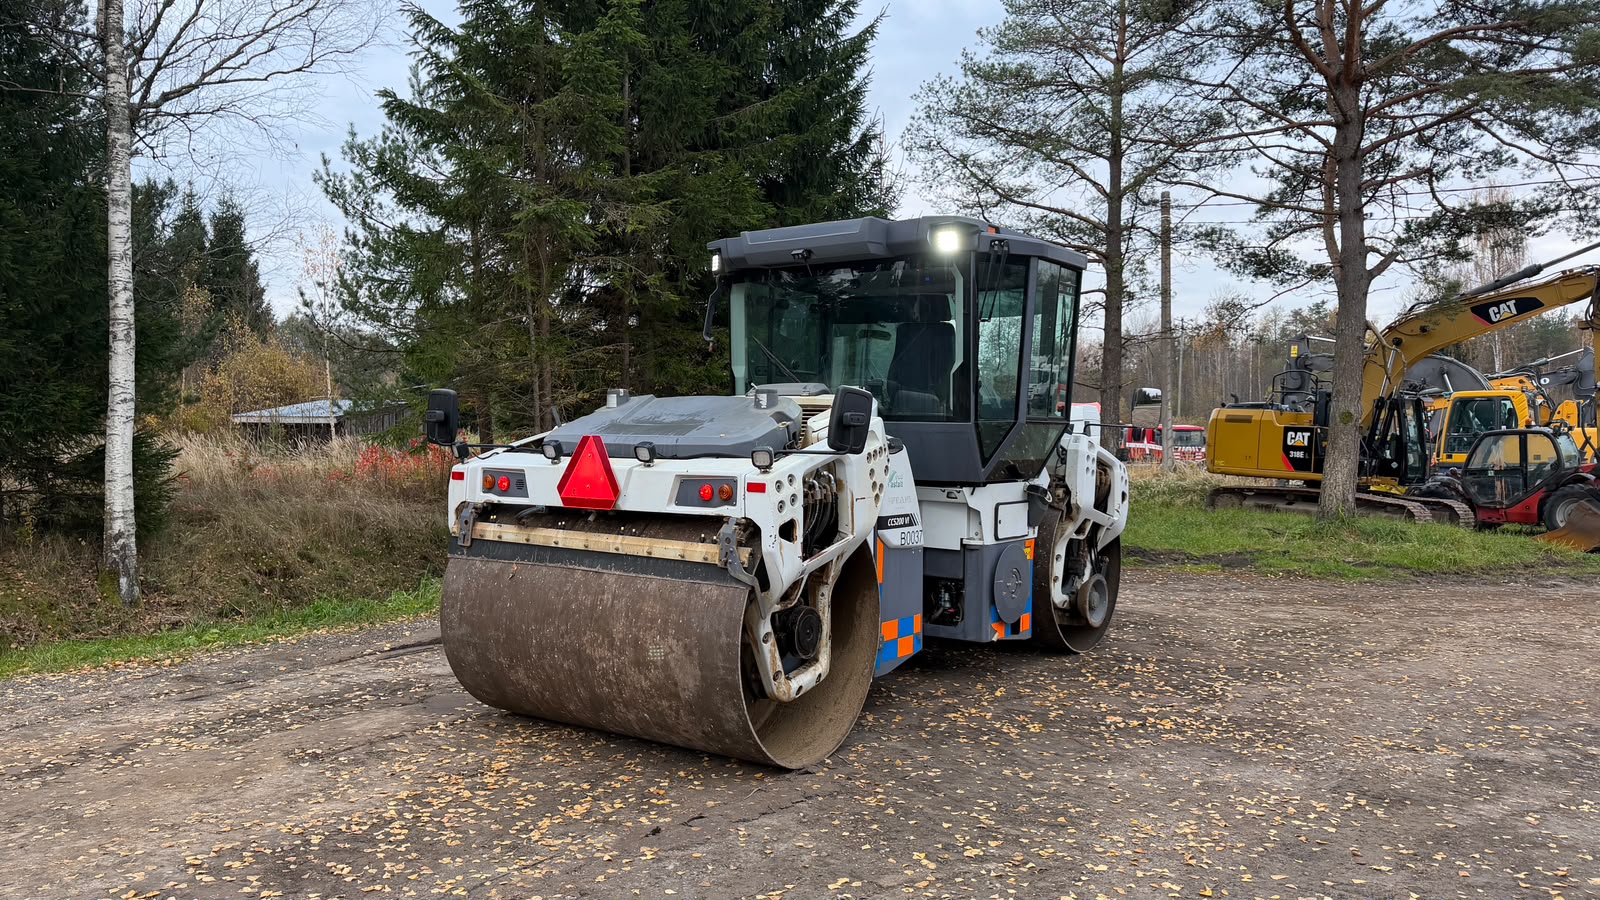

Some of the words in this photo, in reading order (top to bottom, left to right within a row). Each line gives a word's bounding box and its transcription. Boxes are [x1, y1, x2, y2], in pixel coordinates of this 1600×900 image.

[1488, 300, 1517, 322] CAT
[1287, 431, 1311, 446] CAT
[888, 516, 904, 526] CC5200
[901, 530, 922, 545] B0037
